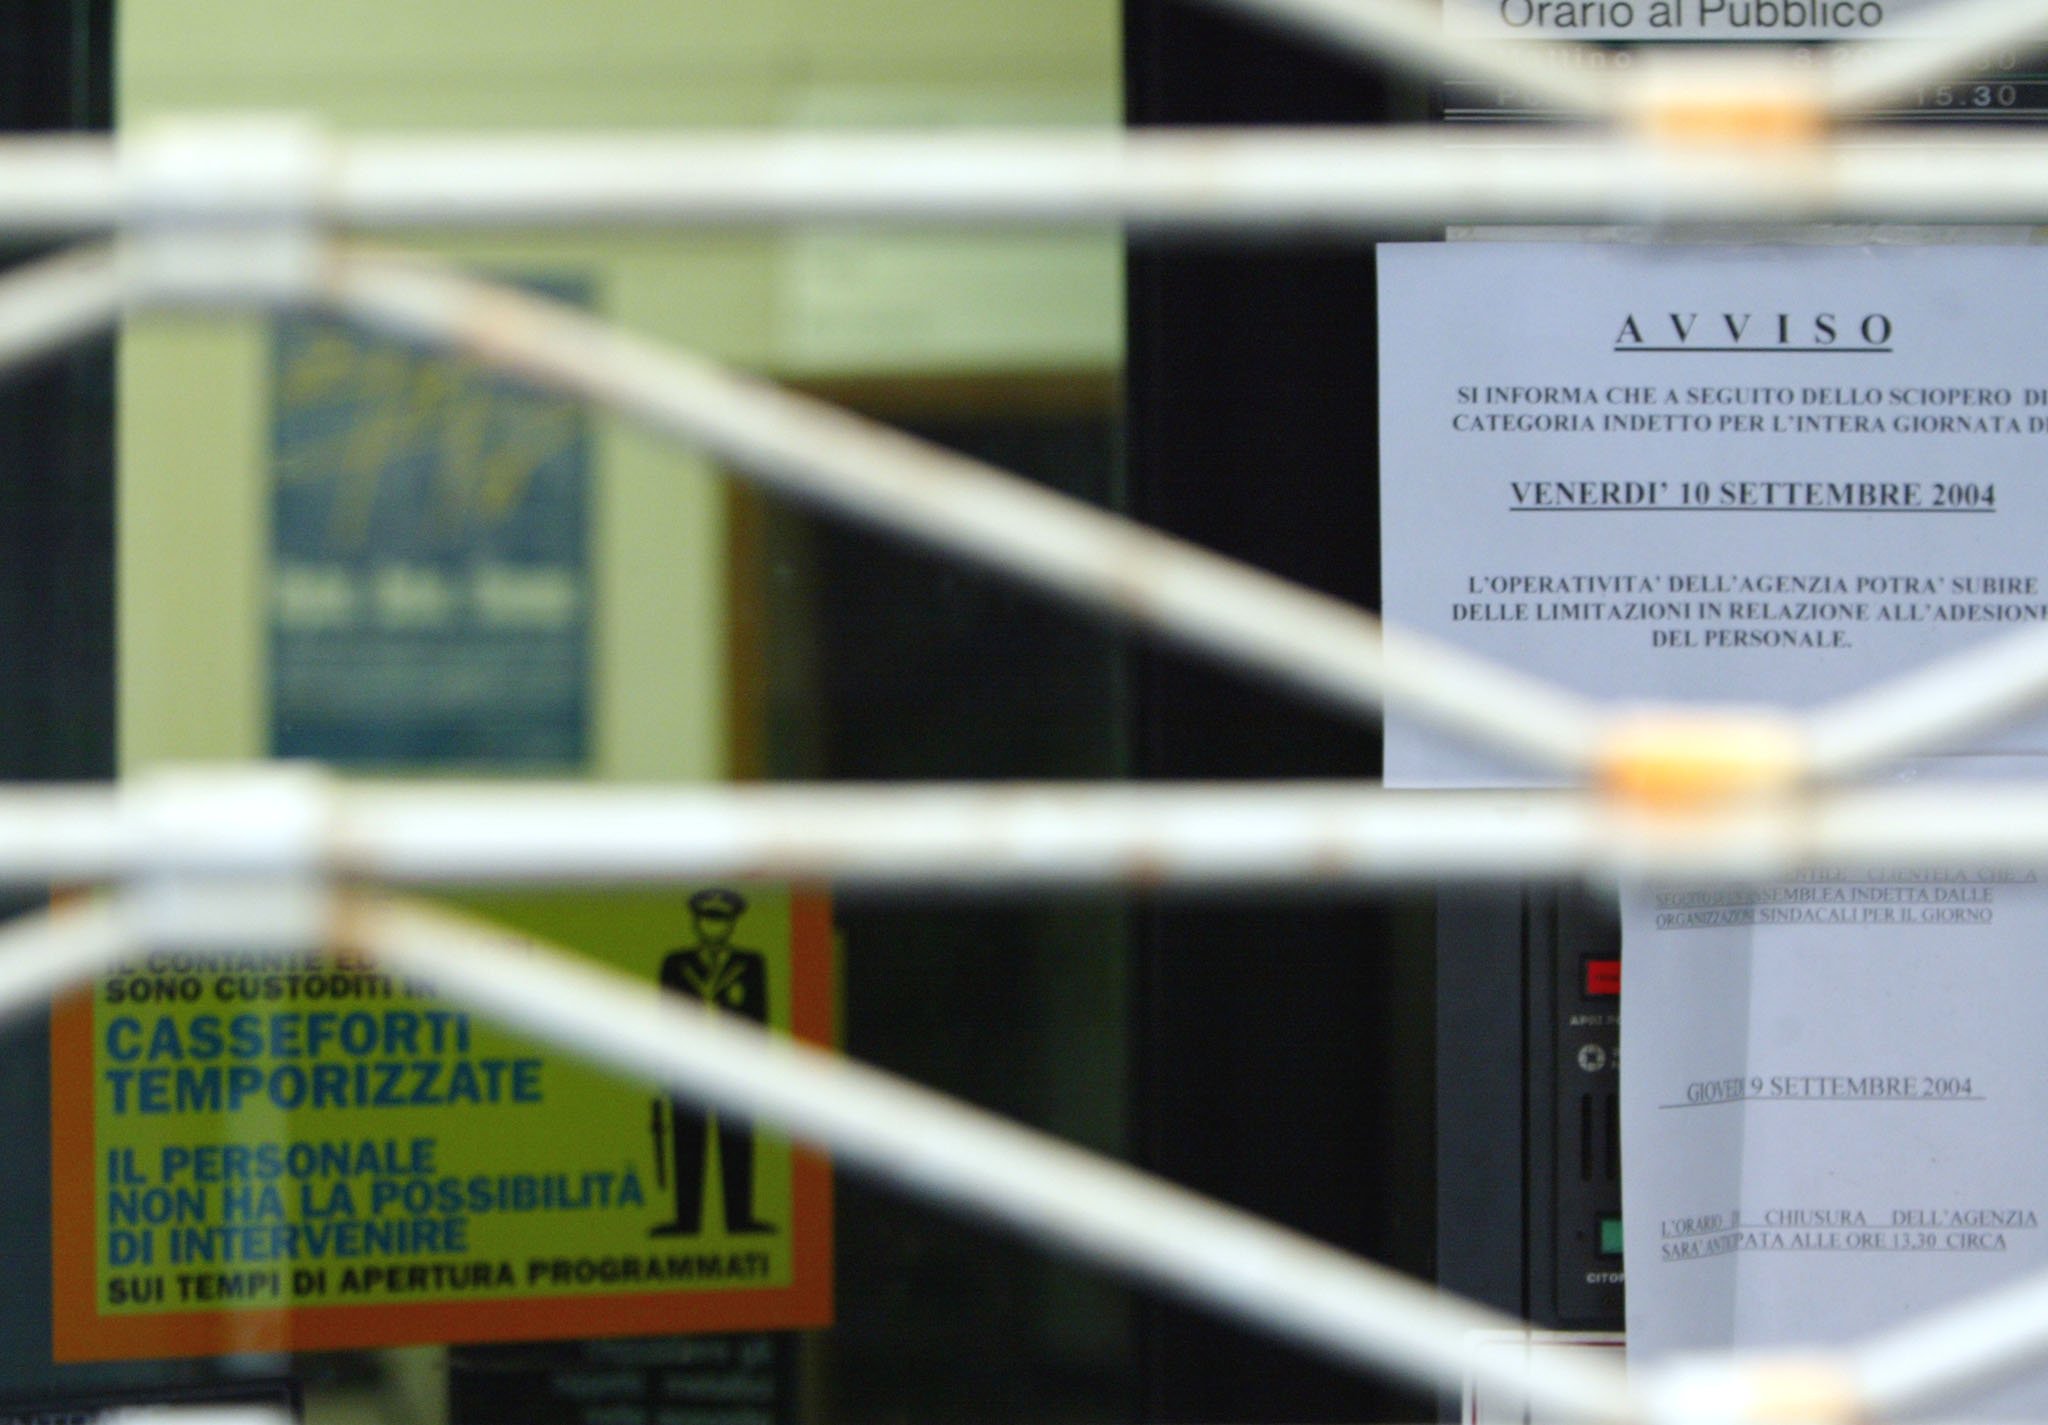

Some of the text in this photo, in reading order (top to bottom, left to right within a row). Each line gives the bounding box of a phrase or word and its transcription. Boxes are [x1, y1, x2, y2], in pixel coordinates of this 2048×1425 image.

[1500, 0, 1883, 28] Orario al Pubblico
[1457, 386, 1479, 404] SI
[1485, 386, 1600, 404] INFORMA
[1605, 387, 1656, 405] CHE
[1663, 388, 1681, 405] A
[1686, 388, 1795, 406] SEGUITO
[1801, 388, 1883, 406] DELLO
[1889, 388, 2012, 407] SCIOPERO
[1452, 414, 2048, 434] CATEGORIA INDETTO PER L'INTERA GIORNATA D
[1510, 482, 1996, 508] VENERDI' 10 SETTEMBRE 2004
[1468, 575, 2038, 595] L'OPERATIVITA' DELL'AGENZIA POTRA' SUBIRE
[1452, 603, 1529, 621] DELLE
[1536, 603, 1691, 621] LIMITAZIONI
[1699, 603, 1721, 620] IN
[1729, 602, 1870, 621] RELAZIONE
[1652, 630, 1853, 648] DEL PERSONALE.
[1852, 887, 1930, 902] INDETTA
[1935, 887, 1993, 902] DALLE
[1760, 908, 1858, 923] SINDACALI
[1863, 908, 1896, 923] PER
[1901, 908, 1917, 922] IL
[1922, 908, 1993, 923] GIORNO
[106, 973, 202, 1003] SONO
[214, 974, 393, 1001] CUSTODITI
[106, 1011, 471, 1062] CASSEFORTI
[107, 1059, 545, 1116] TEMPORIZZATE
[1750, 1077, 1764, 1095] 9
[1770, 1077, 1916, 1097] SETTEMBRE
[1923, 1077, 1973, 1096] 2004
[108, 1138, 437, 1184] IL PERSONALE
[108, 1160, 646, 1225] NON HA LA POSSIBILITÀ
[1661, 1214, 1722, 1238] L'ORARIO
[1764, 1209, 1867, 1226] CHIUSURA
[1891, 1210, 2039, 1228] DELL'AGENZIA
[108, 1217, 468, 1266] DI INTERVENIRE
[1791, 1232, 1841, 1249] ALLE
[1846, 1232, 1885, 1249] ORE
[1946, 1232, 2008, 1250] CIRCA
[108, 1252, 770, 1304] SUI TEMPI DI APERTURA PROGRAMMATI
